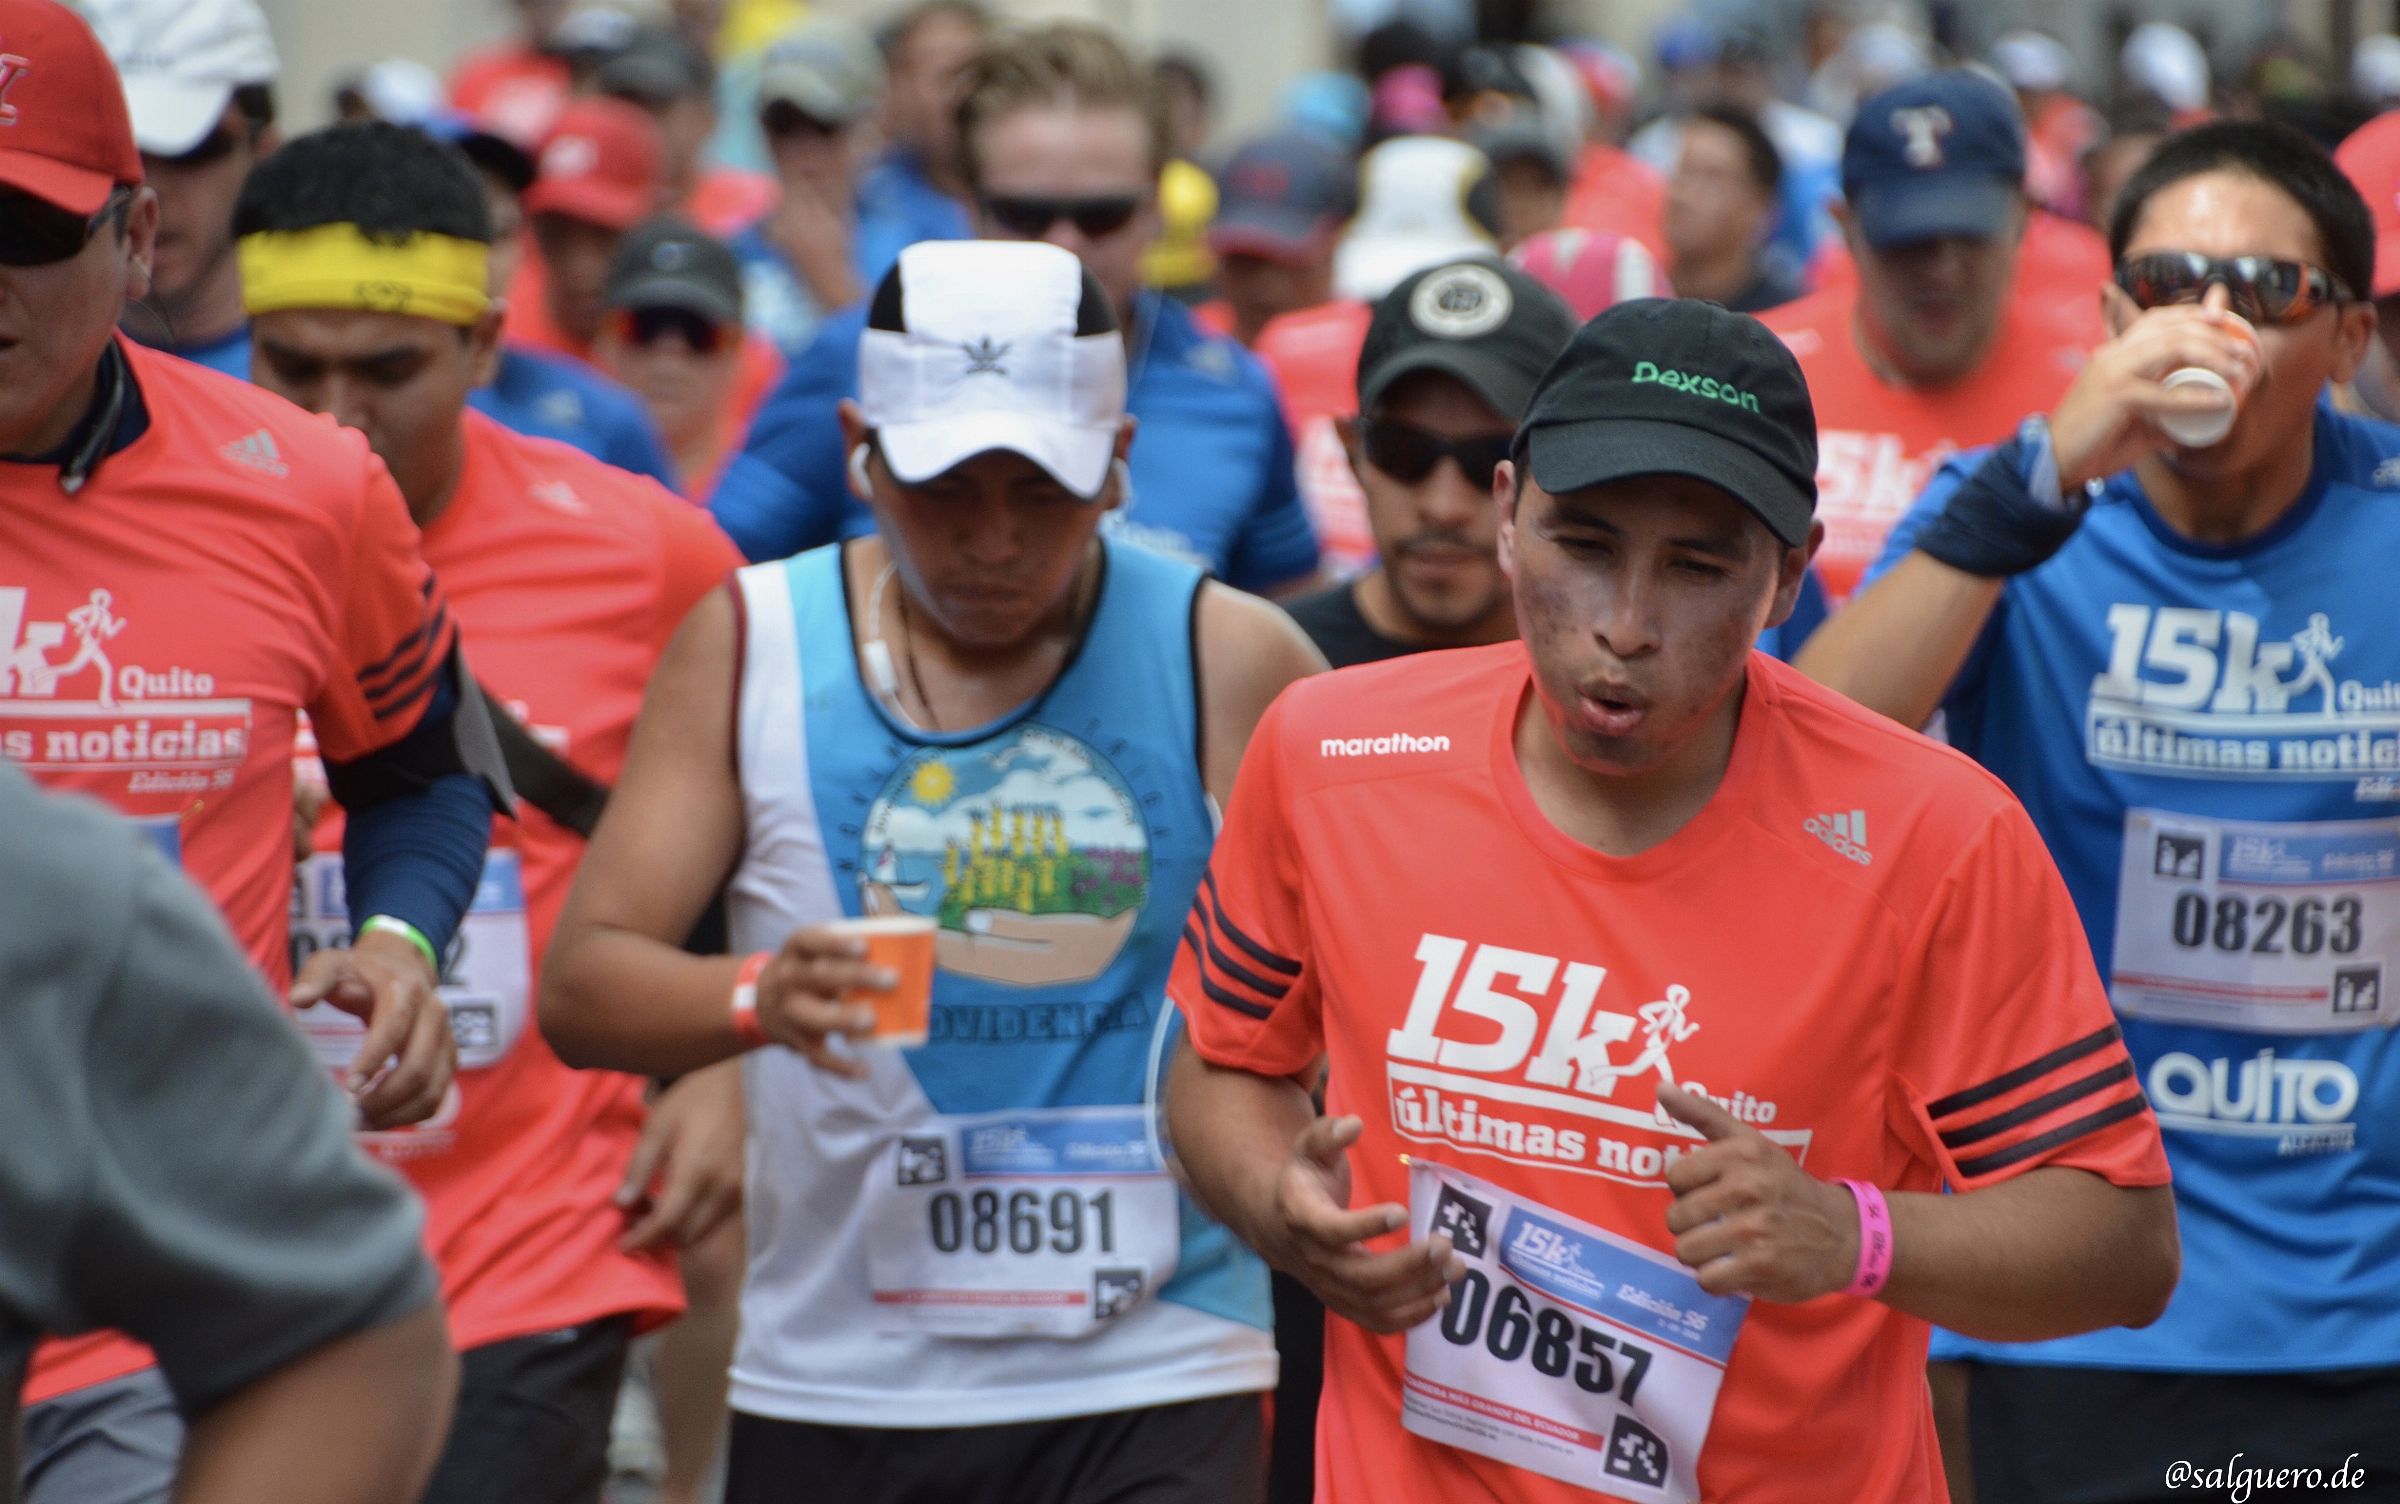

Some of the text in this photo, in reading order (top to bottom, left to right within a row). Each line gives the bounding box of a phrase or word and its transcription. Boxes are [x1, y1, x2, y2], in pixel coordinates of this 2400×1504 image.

[1632, 361, 1761, 415] Dexson
[119, 665, 214, 698] Quito
[2094, 602, 2294, 713] 15k
[2340, 679, 2400, 711] Quit
[46, 720, 245, 762] noticias
[1321, 733, 1450, 757] marathon
[1803, 818, 1872, 866] adidas
[2173, 893, 2363, 954] 08263
[1387, 933, 1637, 1098] 15k
[1681, 1081, 1777, 1124] Qito
[2150, 1047, 2360, 1124] QUITO
[1396, 1086, 1587, 1162] últimas
[930, 1188, 1115, 1254] 08691
[1511, 1220, 1570, 1266] 15k
[1440, 1267, 1653, 1409] 06857
